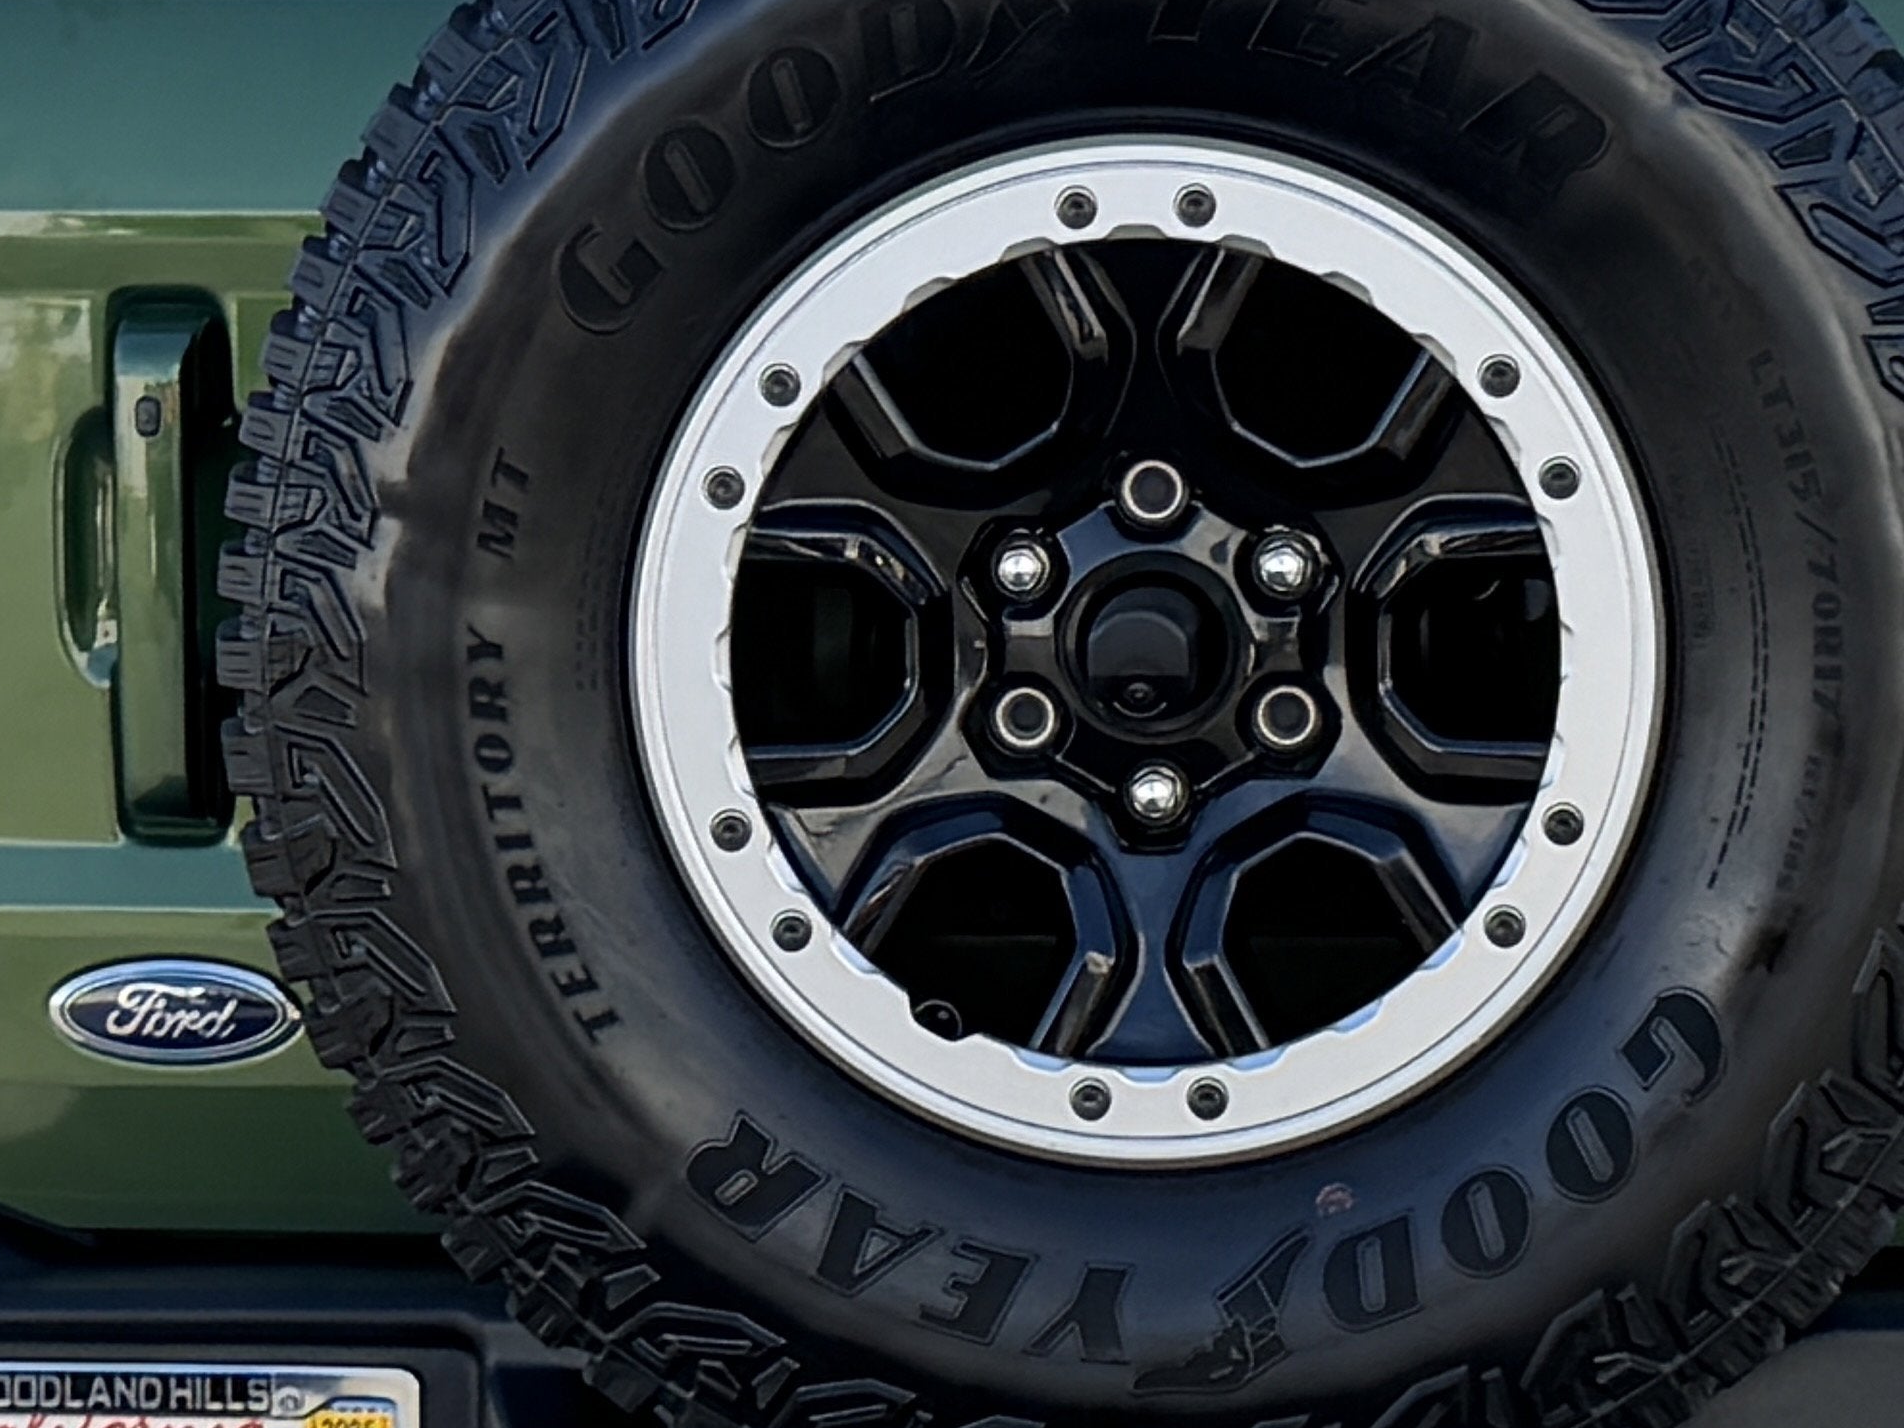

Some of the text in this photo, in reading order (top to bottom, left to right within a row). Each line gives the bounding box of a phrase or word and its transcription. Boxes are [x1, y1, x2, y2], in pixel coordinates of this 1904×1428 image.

[466, 624, 620, 1045] TERRITORY
[105, 982, 239, 1039] Ford
[685, 986, 1724, 1366] GOOD YEAR
[170, 1377, 271, 1411] HILLS
